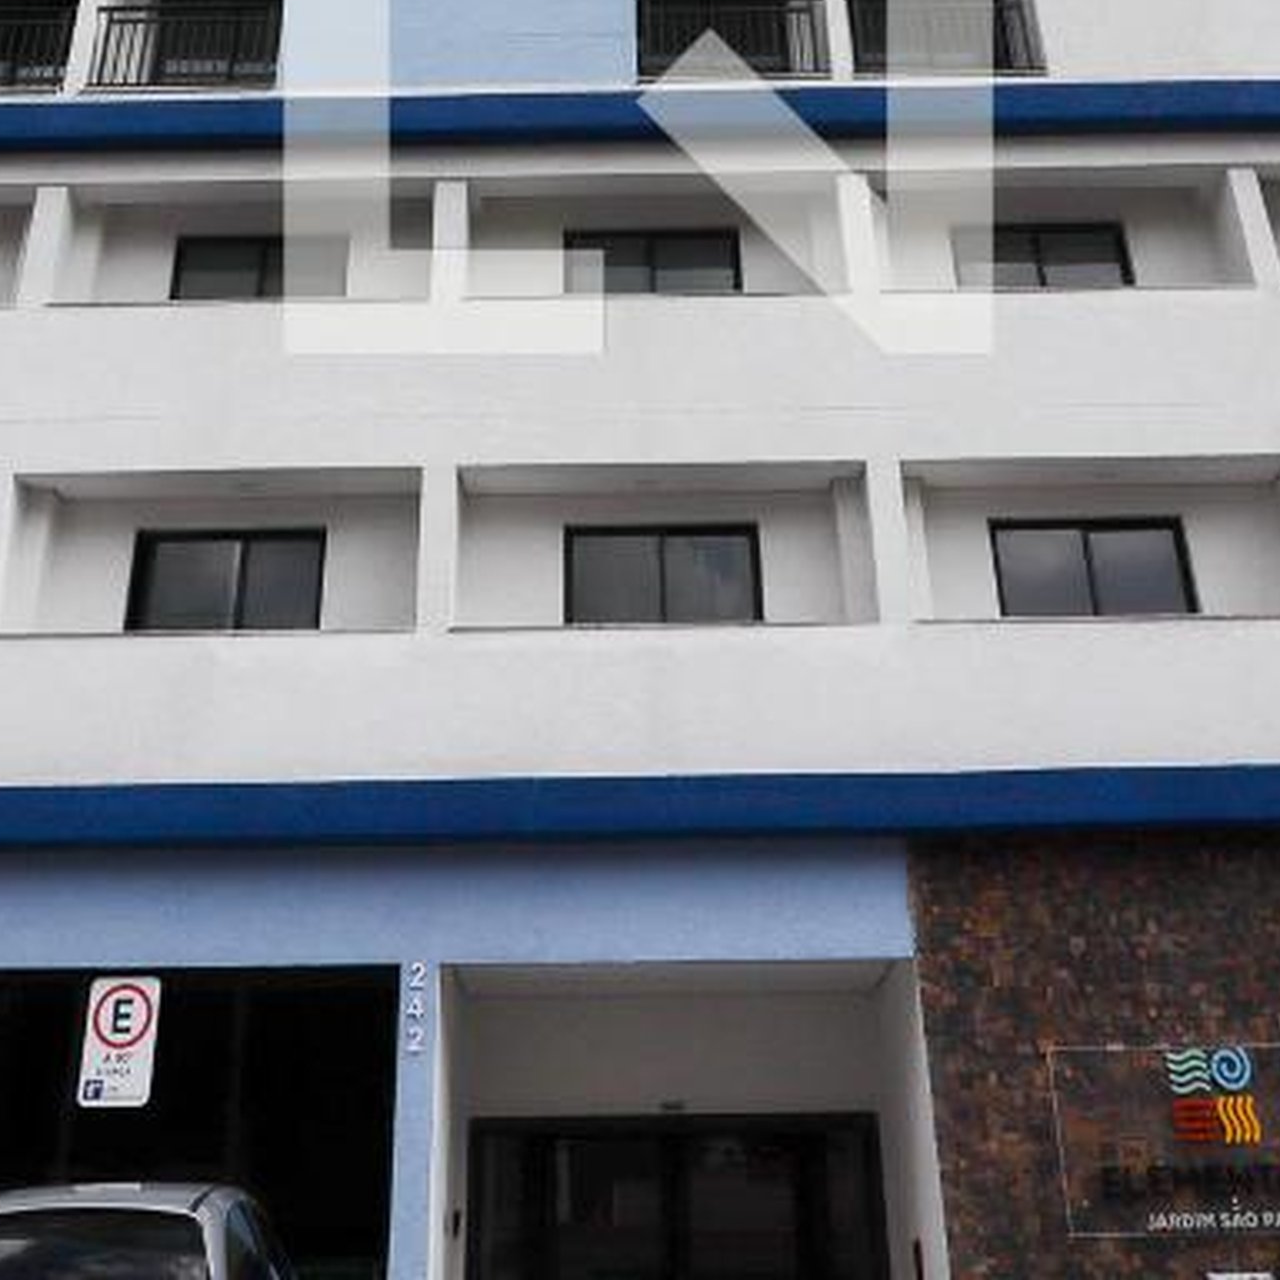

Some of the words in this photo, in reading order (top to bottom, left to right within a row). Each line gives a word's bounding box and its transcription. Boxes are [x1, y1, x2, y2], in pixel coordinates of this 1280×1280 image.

[111, 998, 135, 1035] E
[406, 961, 426, 1053] 242
[1146, 1212, 1217, 1231] JARDIM
[1220, 1206, 1258, 1229] SÃO
